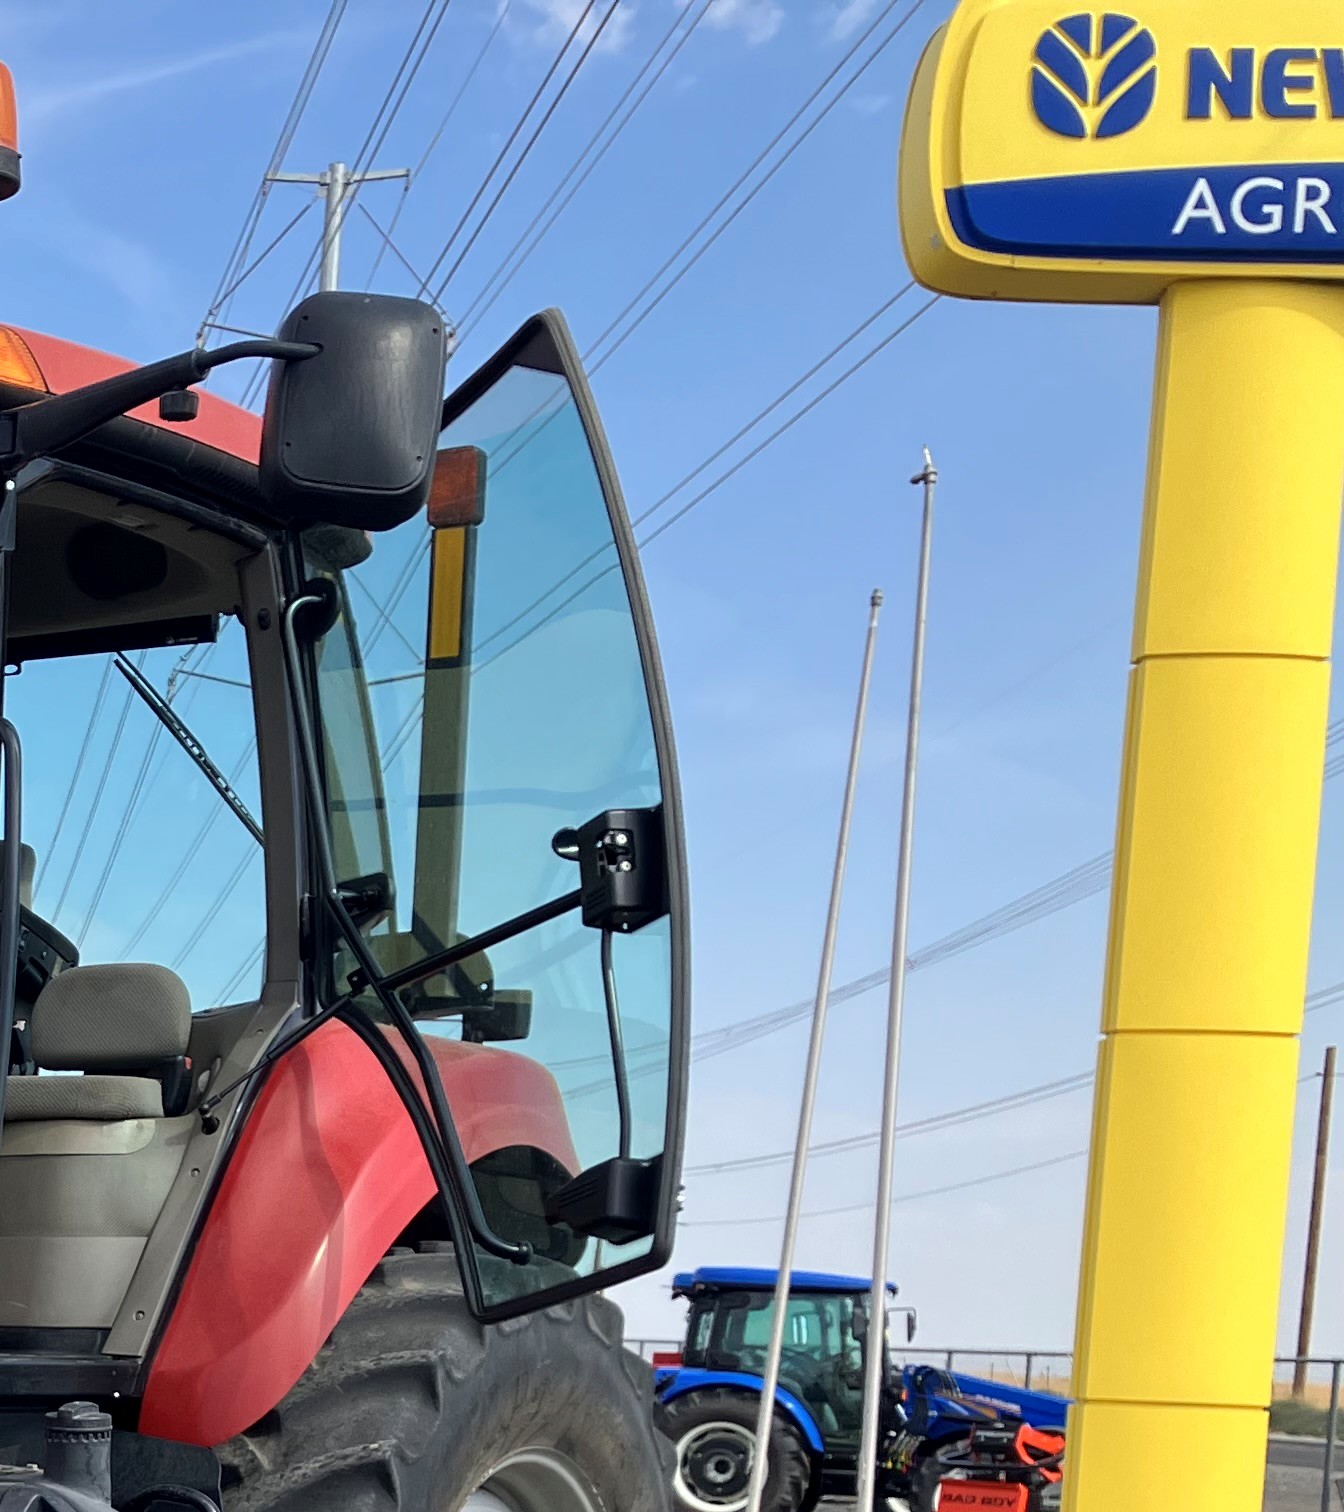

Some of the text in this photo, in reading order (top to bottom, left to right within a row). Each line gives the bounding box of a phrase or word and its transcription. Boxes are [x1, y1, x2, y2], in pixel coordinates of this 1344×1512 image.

[1187, 47, 1344, 119] NE
[1172, 177, 1337, 235] AGR
[943, 1493, 976, 1502] BAD
